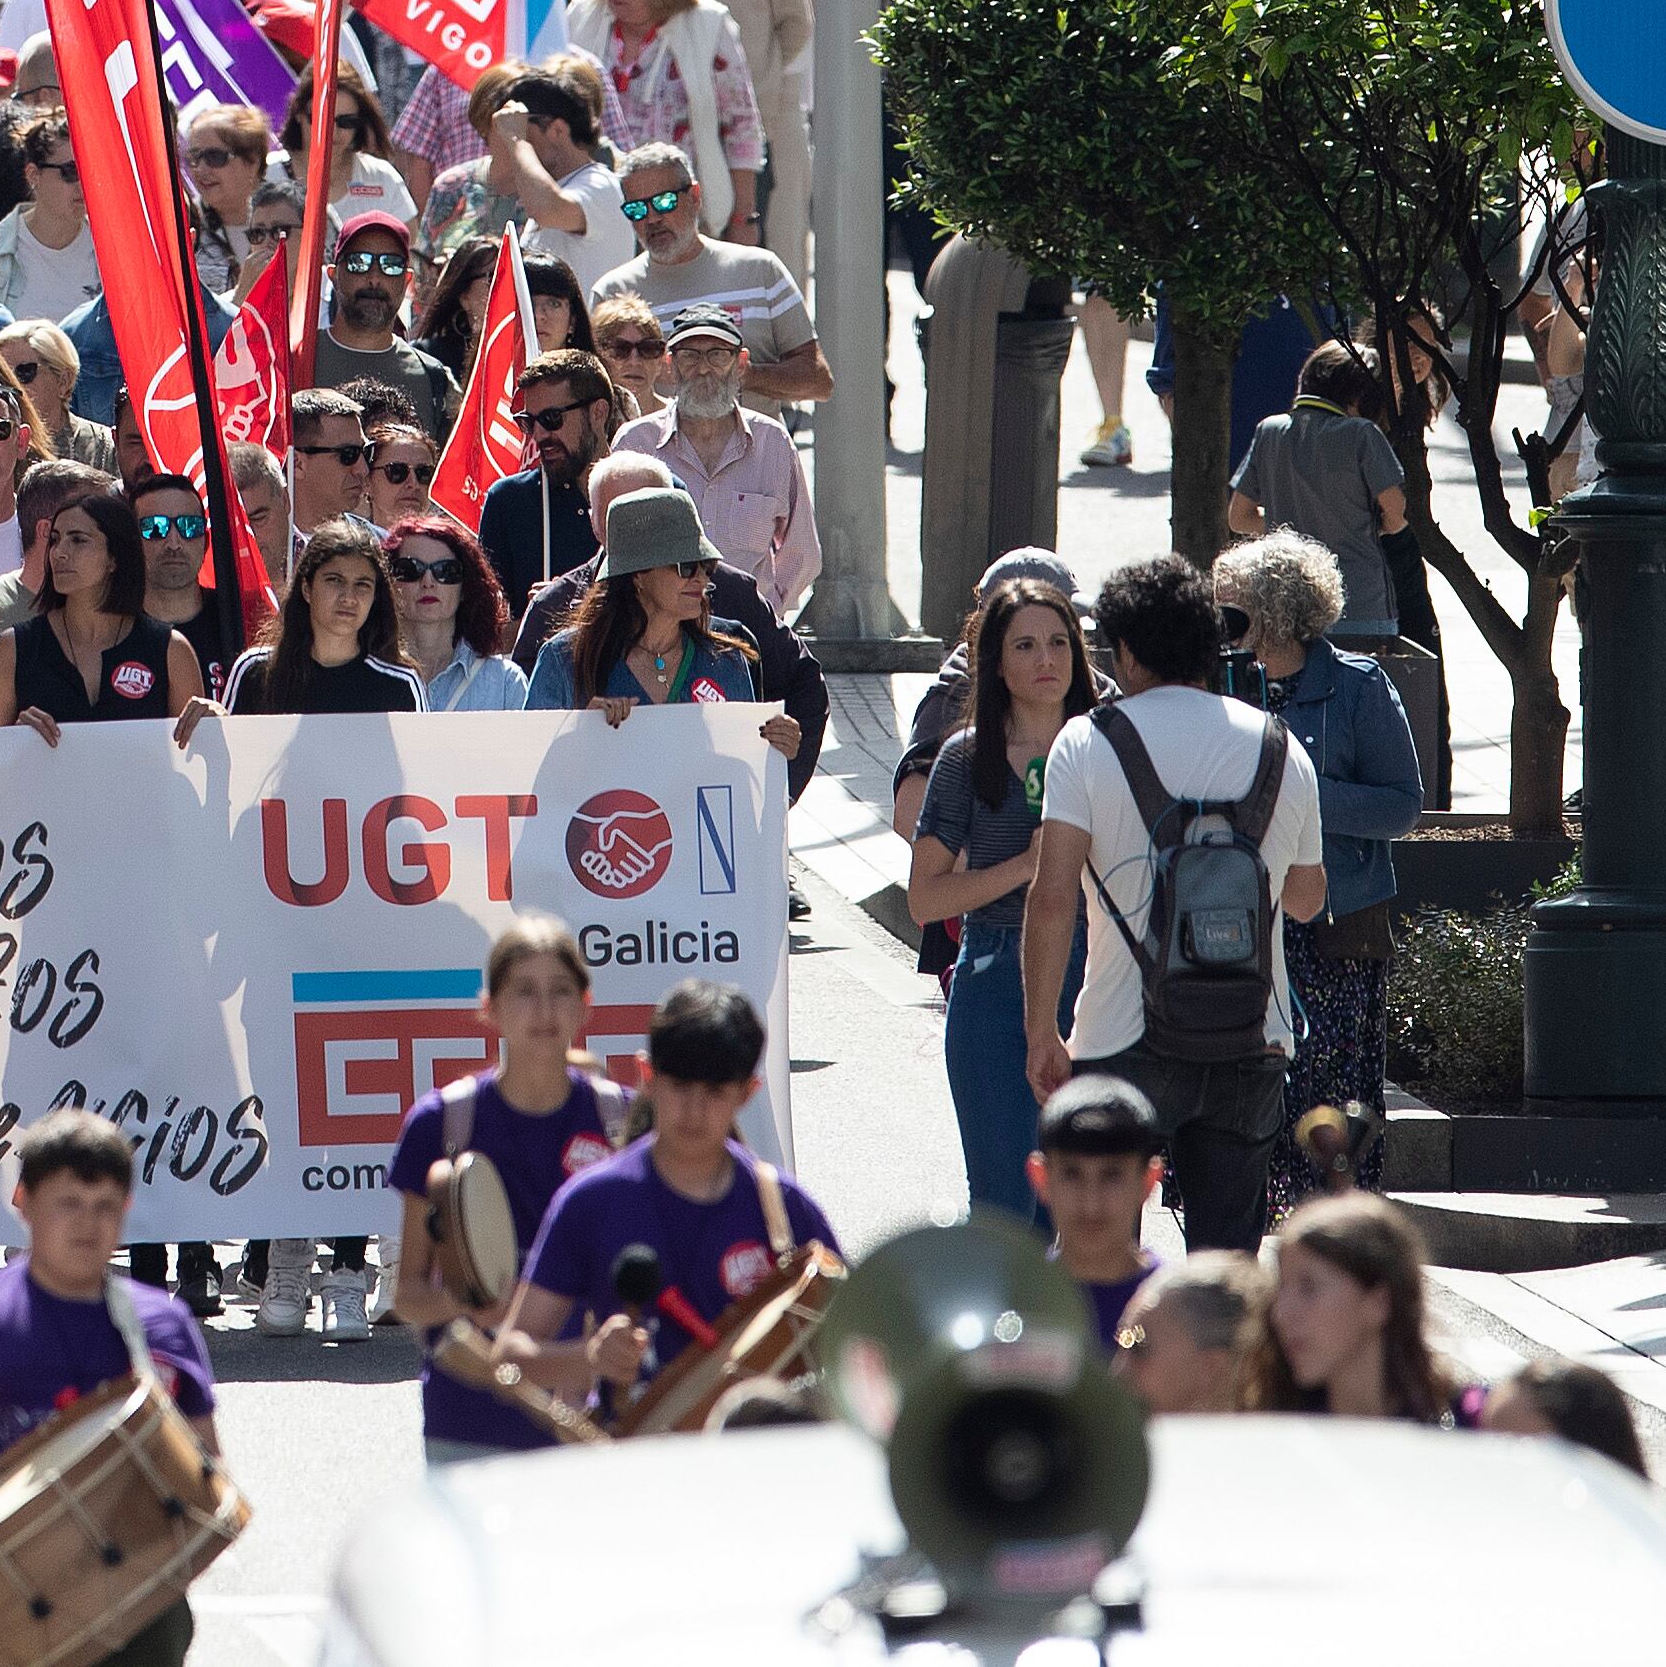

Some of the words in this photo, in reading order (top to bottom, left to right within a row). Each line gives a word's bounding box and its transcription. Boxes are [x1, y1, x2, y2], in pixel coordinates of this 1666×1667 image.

[115, 666, 154, 686] UGT
[260, 794, 537, 905] UGT
[580, 921, 740, 967] Galicia
